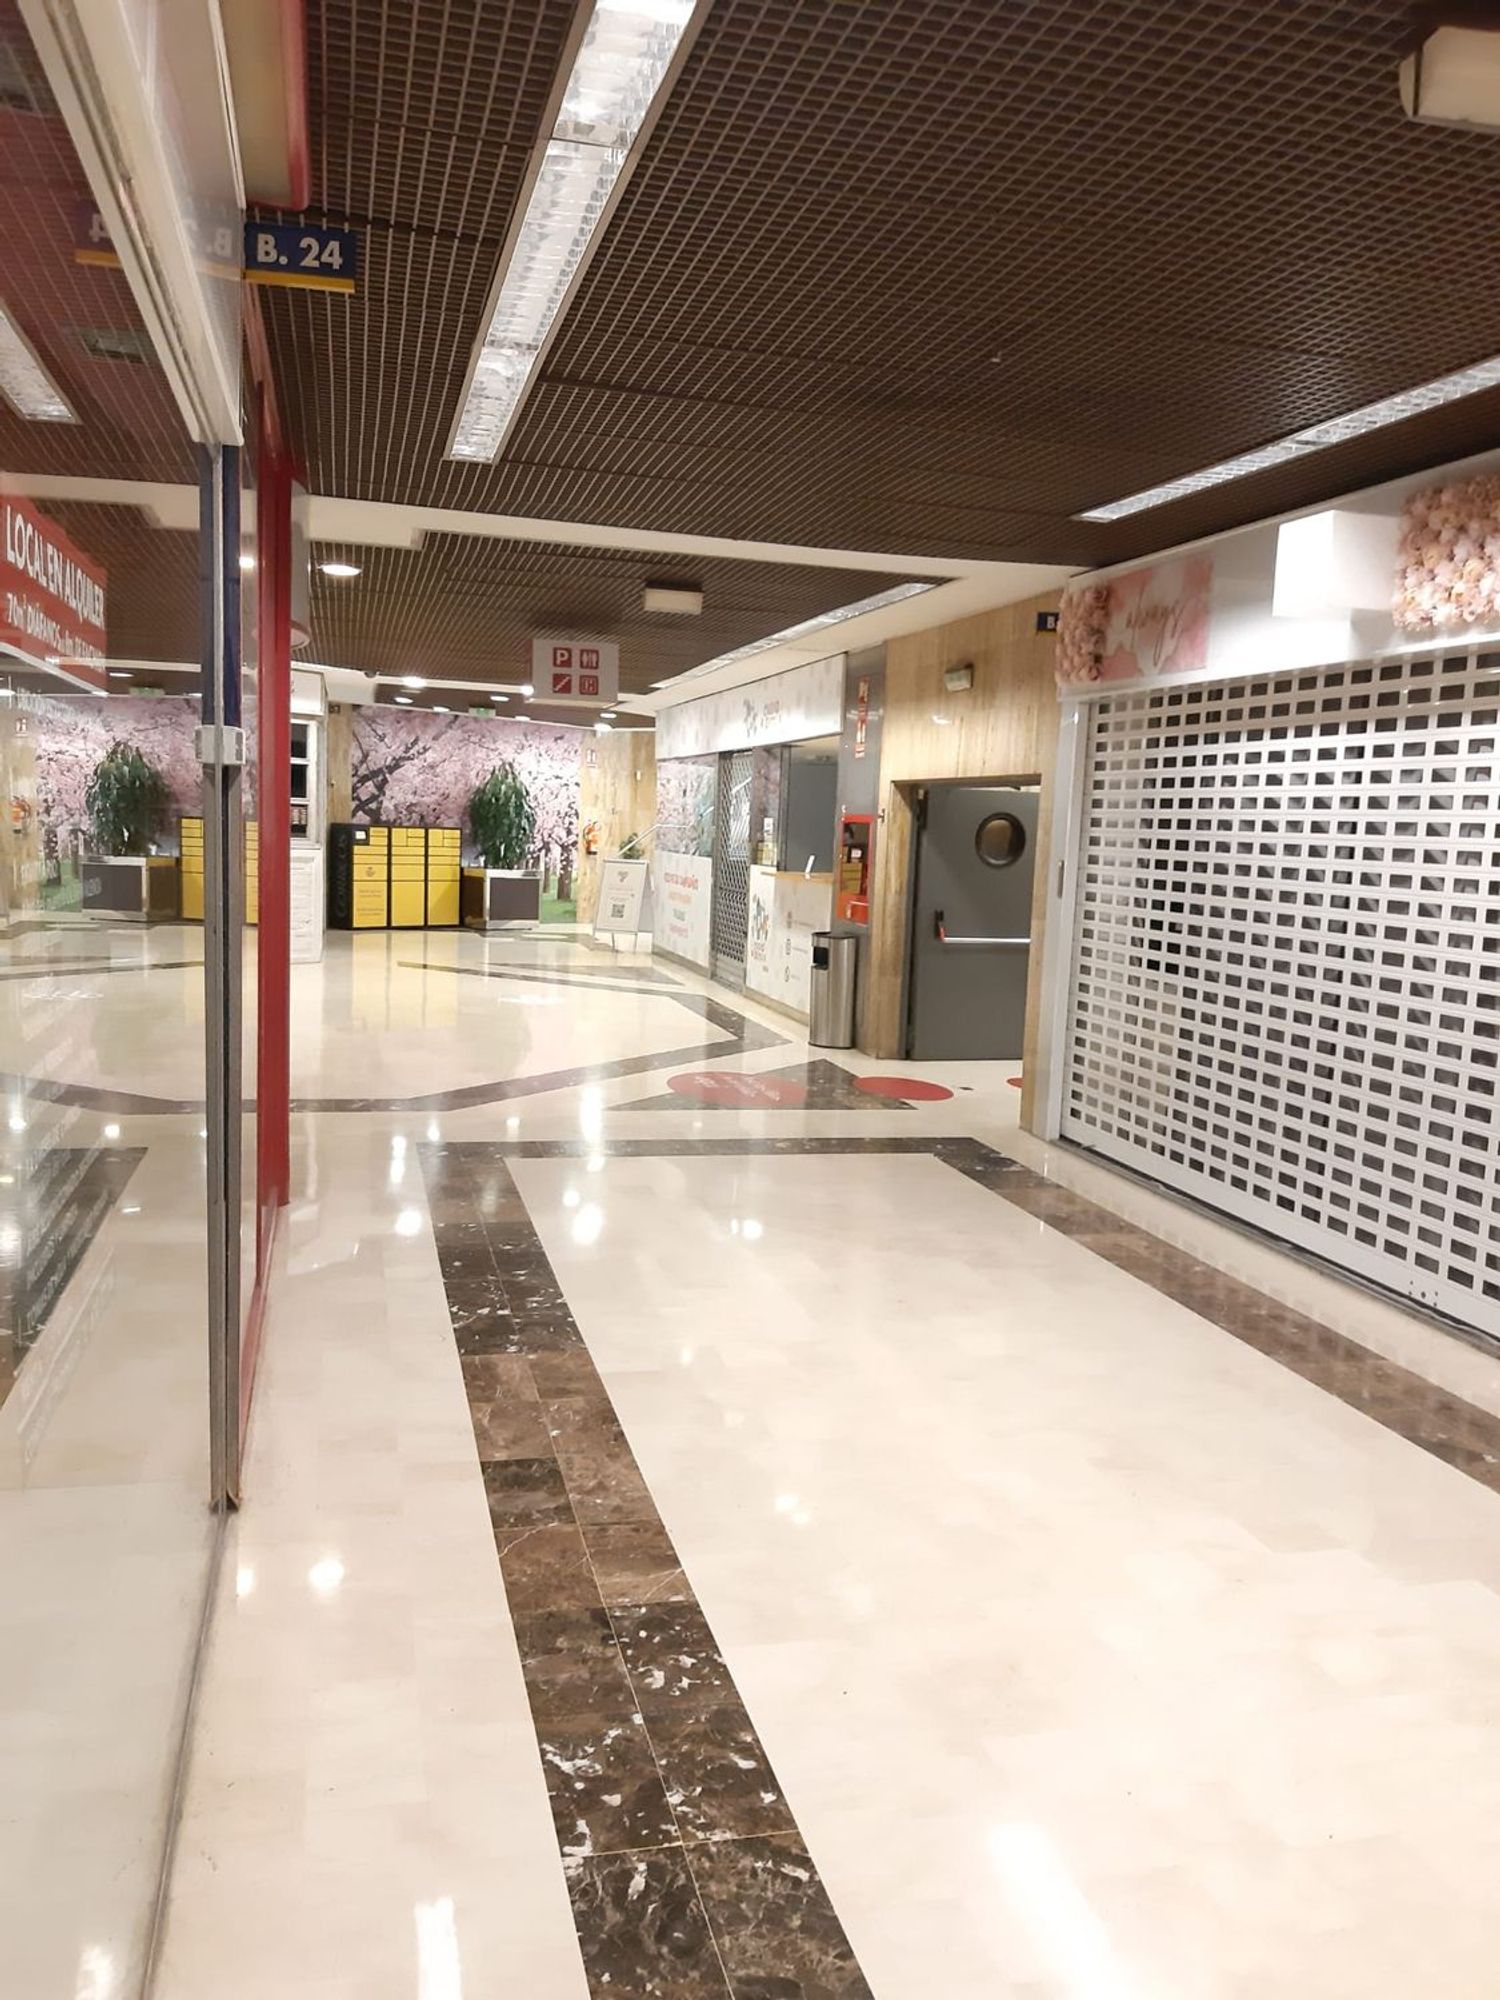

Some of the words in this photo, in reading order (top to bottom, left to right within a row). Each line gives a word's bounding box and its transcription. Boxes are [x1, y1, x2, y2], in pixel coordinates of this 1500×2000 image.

[256, 233, 288, 266] B.
[300, 237, 343, 271] 24
[6, 504, 47, 587] LOCAL
[47, 542, 63, 599] EN
[64, 558, 105, 630] ALQUILER
[556, 649, 569, 666] P
